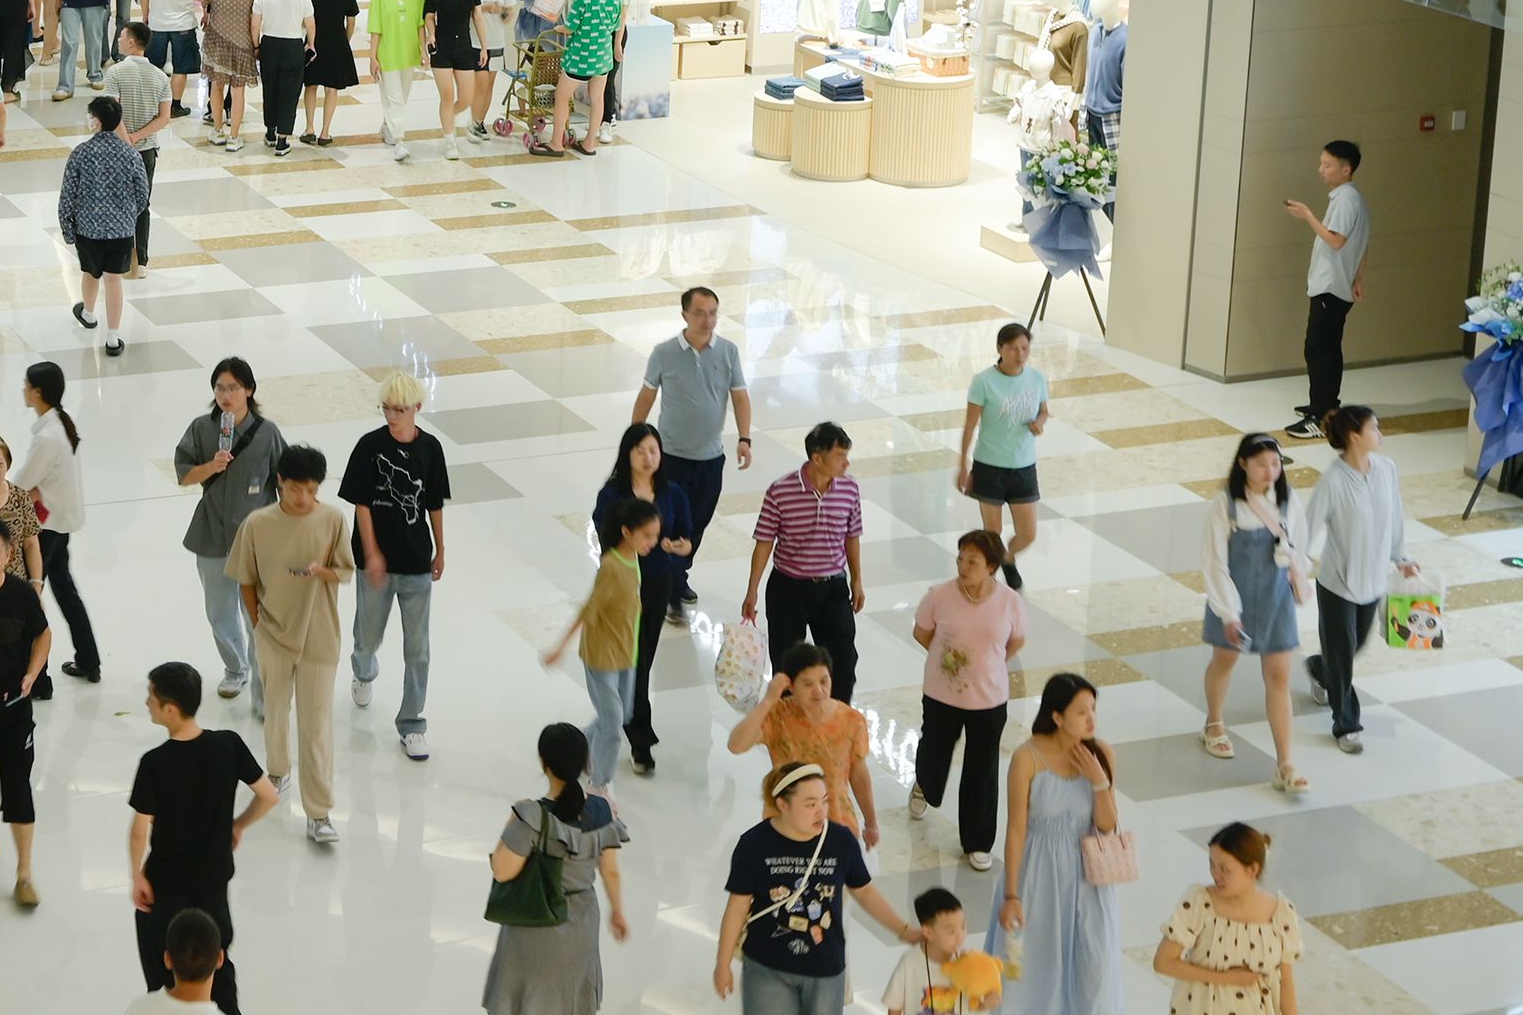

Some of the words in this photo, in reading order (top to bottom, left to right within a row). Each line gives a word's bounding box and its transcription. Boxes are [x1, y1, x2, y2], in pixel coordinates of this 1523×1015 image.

[764, 856, 805, 866] WHATEVER
[805, 857, 822, 866] YU
[823, 857, 837, 867] ARE
[770, 865, 795, 875] DOING
[794, 866, 817, 875] RIGT
[817, 867, 835, 876] NOW
